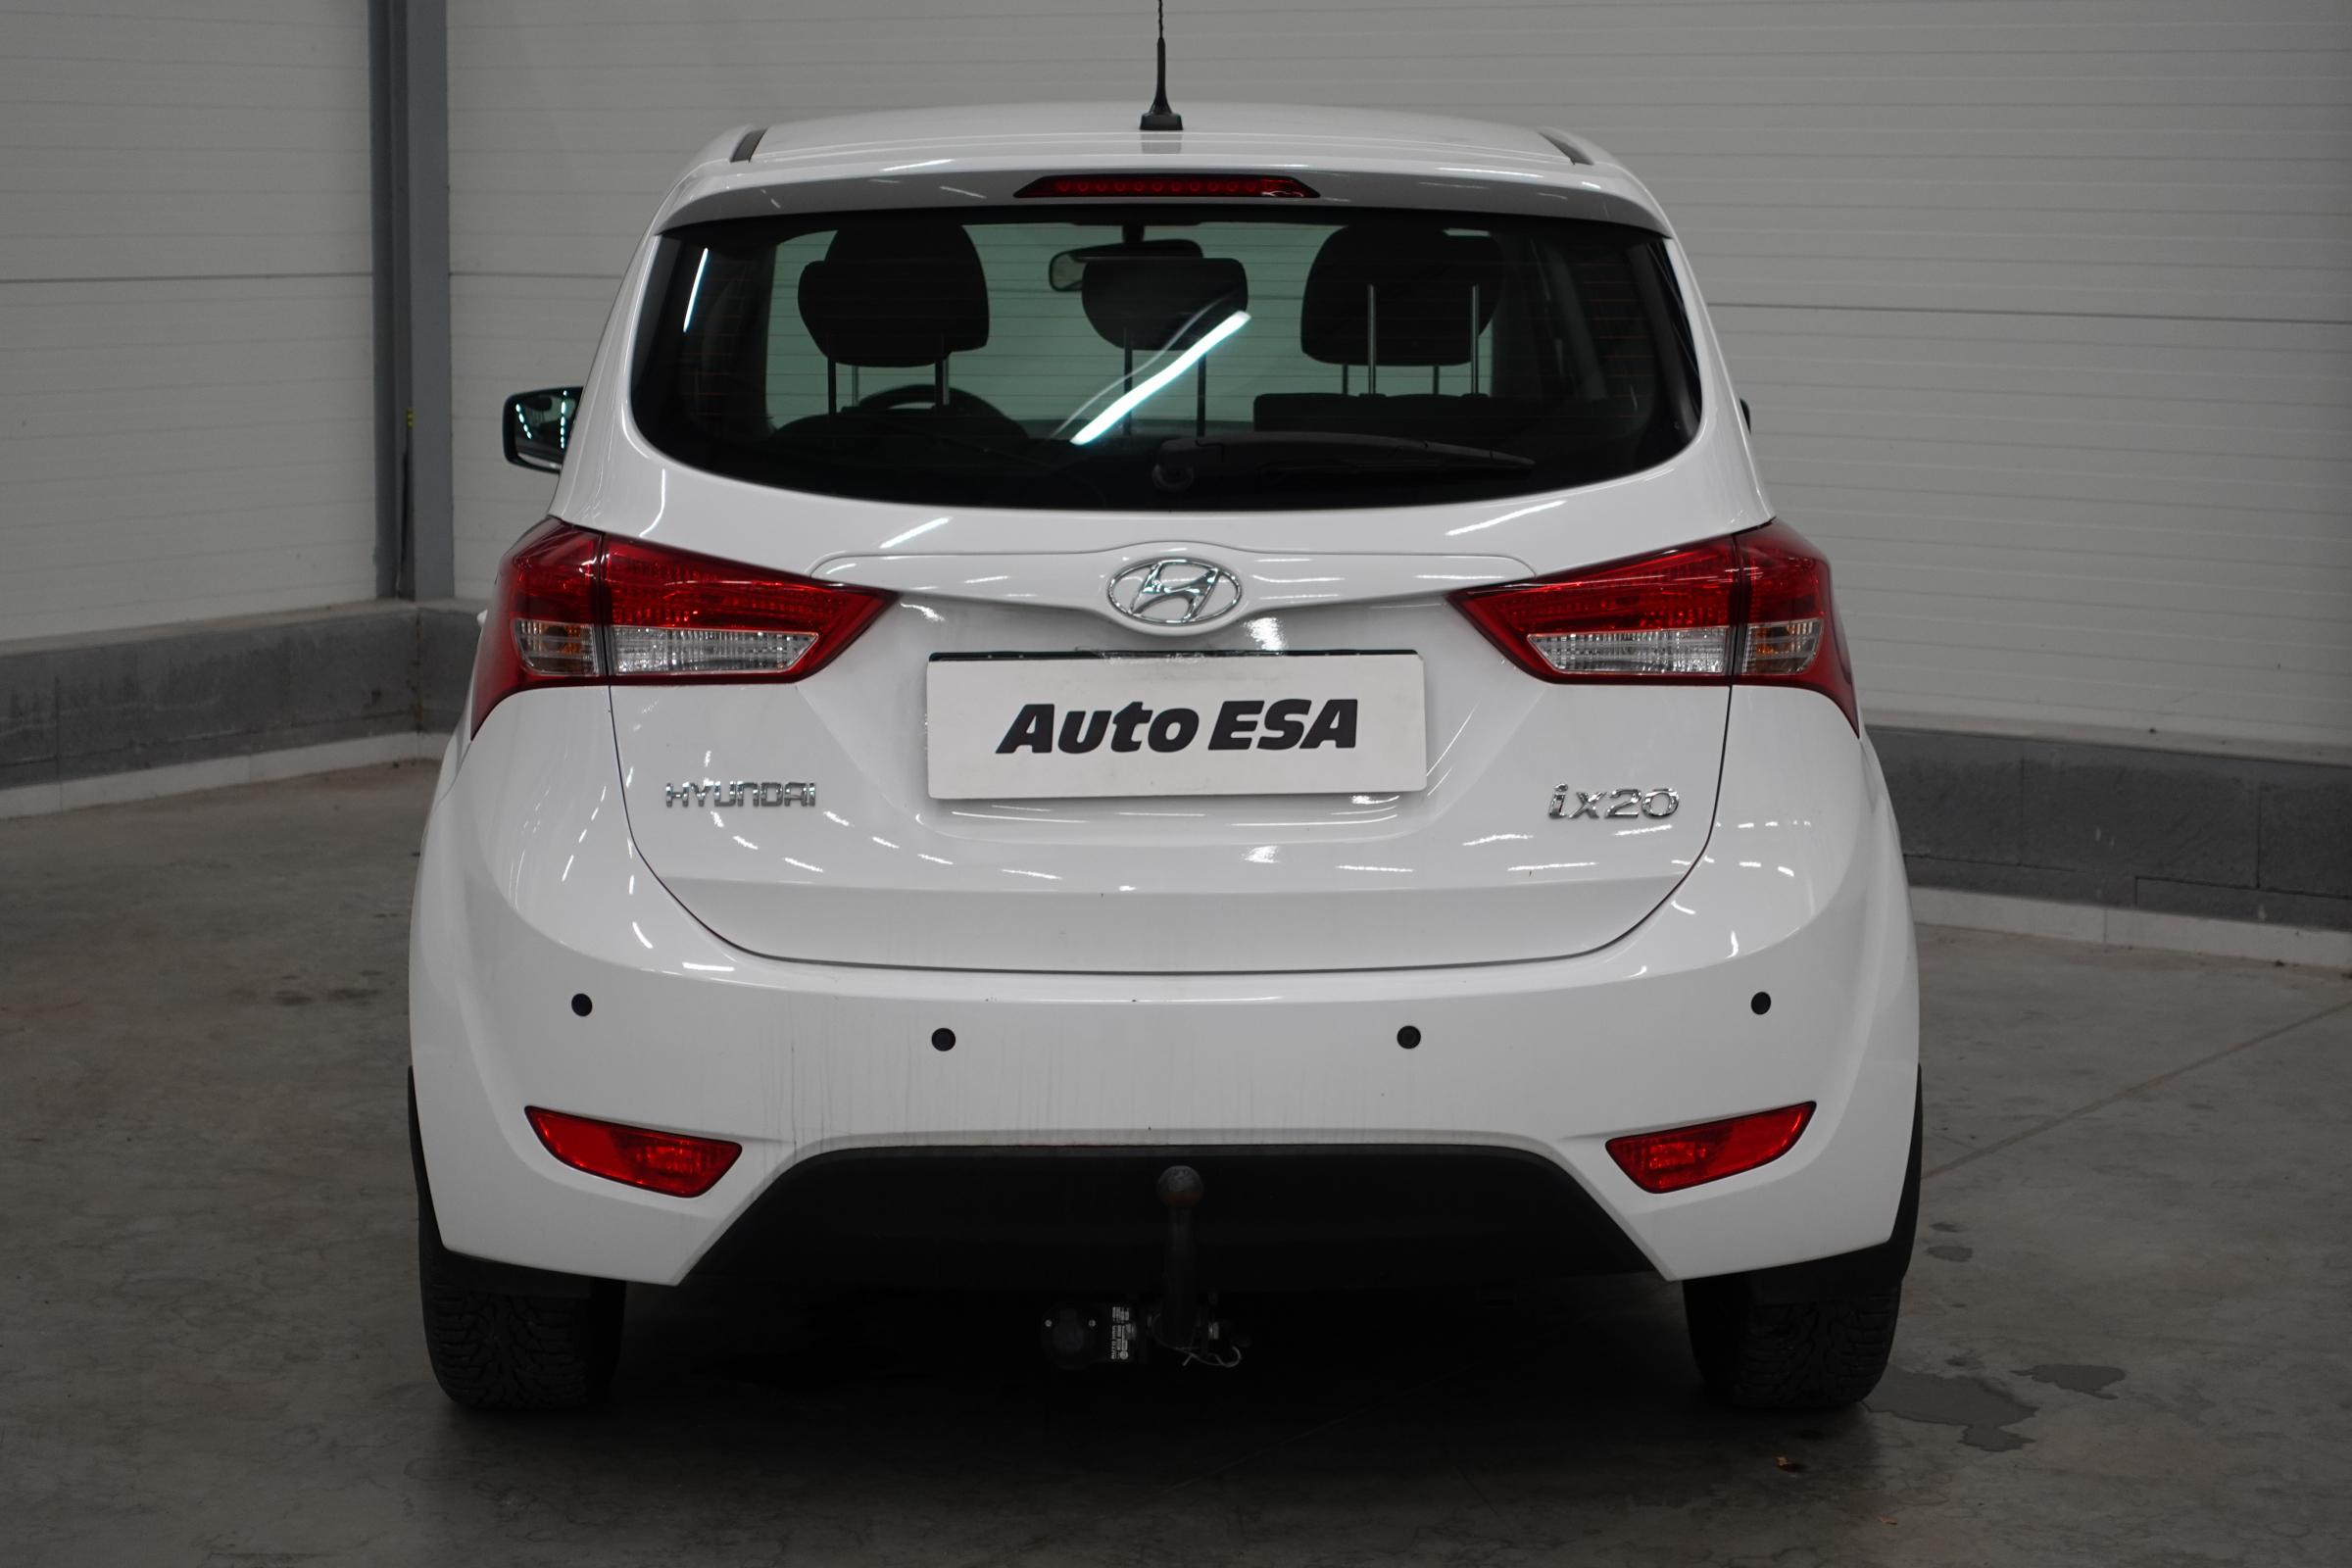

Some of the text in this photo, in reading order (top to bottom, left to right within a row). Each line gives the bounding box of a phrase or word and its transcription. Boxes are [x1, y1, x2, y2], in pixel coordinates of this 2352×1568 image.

[995, 699, 1358, 755] Auto ESA
[665, 781, 816, 808] HYUNDAI
[1547, 783, 1680, 819] ix20
